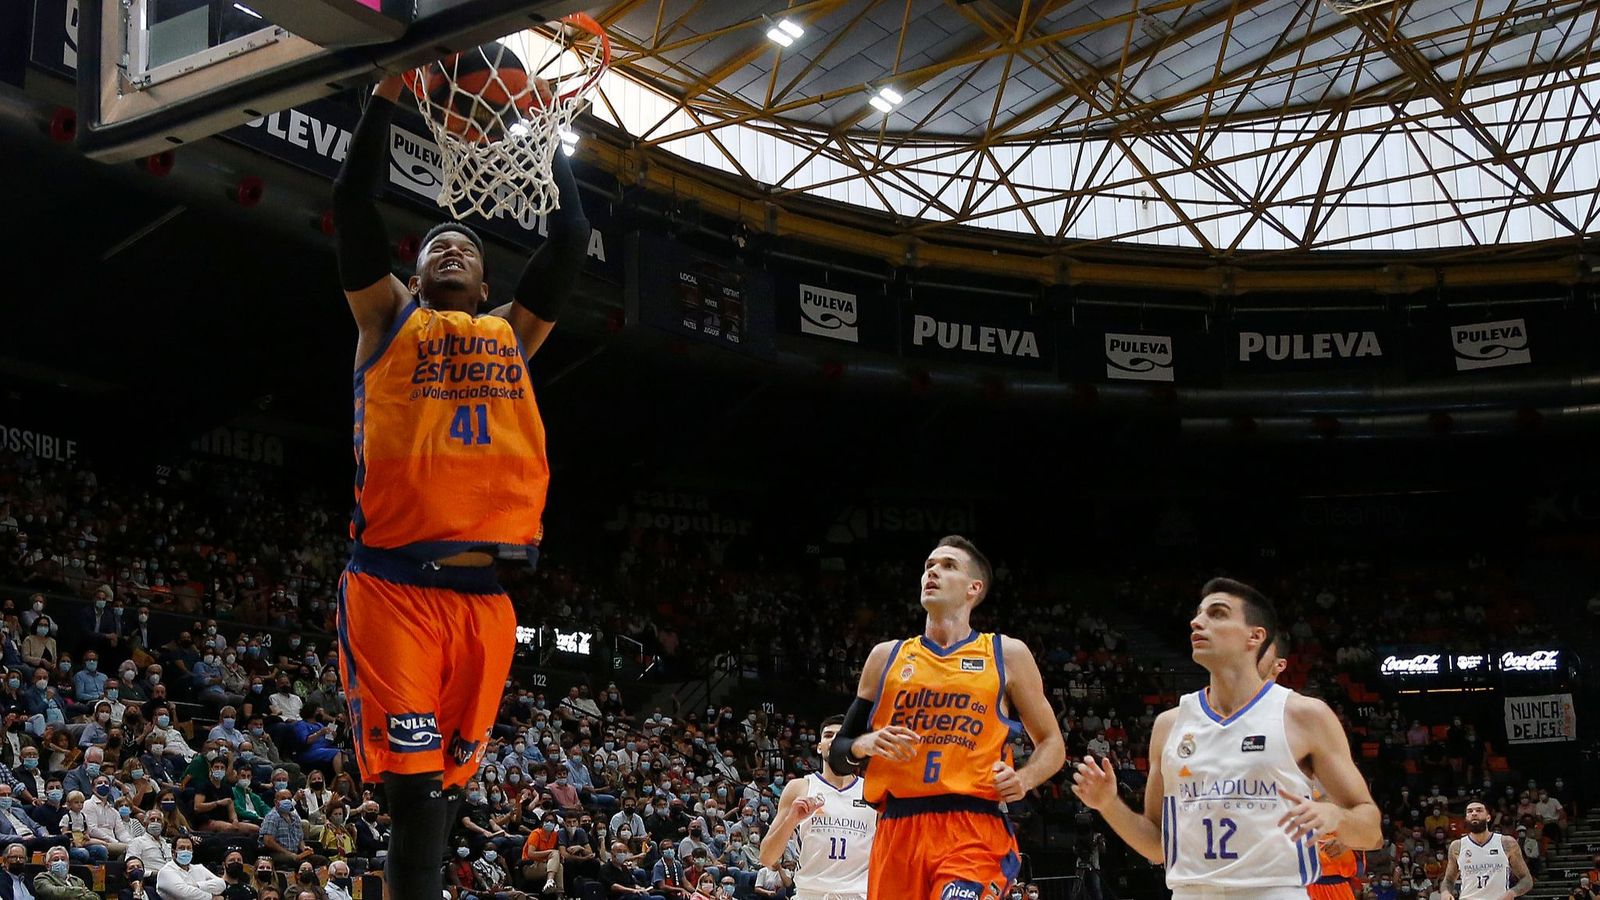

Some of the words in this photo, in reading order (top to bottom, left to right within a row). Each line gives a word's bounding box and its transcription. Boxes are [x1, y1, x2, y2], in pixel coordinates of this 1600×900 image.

[394, 133, 443, 169] PULEV
[803, 290, 854, 313] PULEVA
[913, 314, 1040, 358] PULEVA
[1110, 338, 1169, 355] PULEVA
[1239, 331, 1382, 361] PULEVA
[1457, 326, 1522, 344] PULEVA
[411, 360, 523, 384] Esfuerzo
[409, 385, 524, 401] @ValenciaBasket
[450, 404, 491, 445] 41
[532, 674, 547, 687] 122
[761, 702, 775, 714] 121
[894, 688, 970, 710] Cultura
[971, 701, 988, 715] del
[1511, 701, 1559, 720] NUNCA
[890, 709, 984, 736] Esfuerzo
[919, 733, 977, 751] nciaBasket
[923, 750, 942, 784] 6
[811, 816, 868, 831] PALLADIUM
[828, 837, 847, 860] 11
[1202, 818, 1238, 859] 12
[1477, 875, 1490, 889] 17
